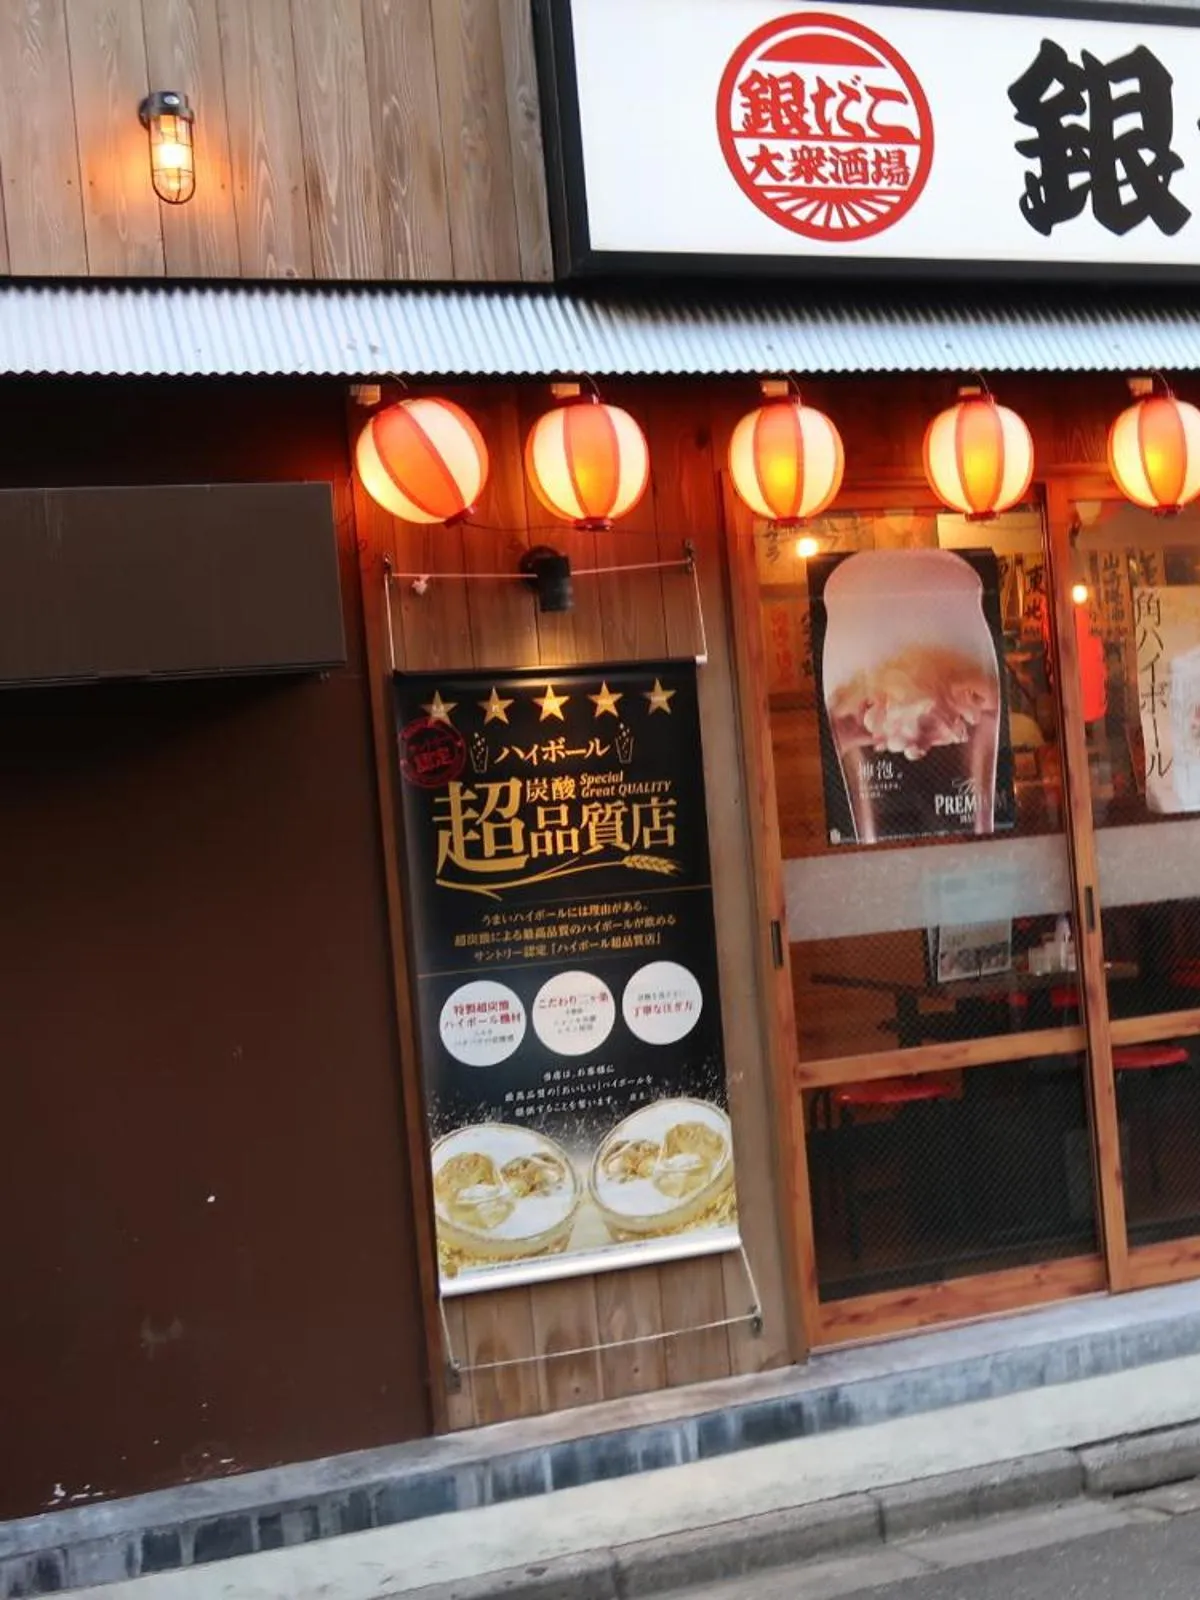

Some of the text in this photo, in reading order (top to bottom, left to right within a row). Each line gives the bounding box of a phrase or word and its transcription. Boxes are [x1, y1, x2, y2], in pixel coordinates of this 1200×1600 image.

[738, 70, 914, 141] 銀だこ
[747, 145, 910, 188] 大衆酒場
[1134, 591, 1174, 779] 角ハイボール
[493, 737, 612, 766] ハイボール
[525, 775, 577, 803] 炭酸
[579, 769, 624, 788] Special
[580, 780, 672, 799] Great QUALITY
